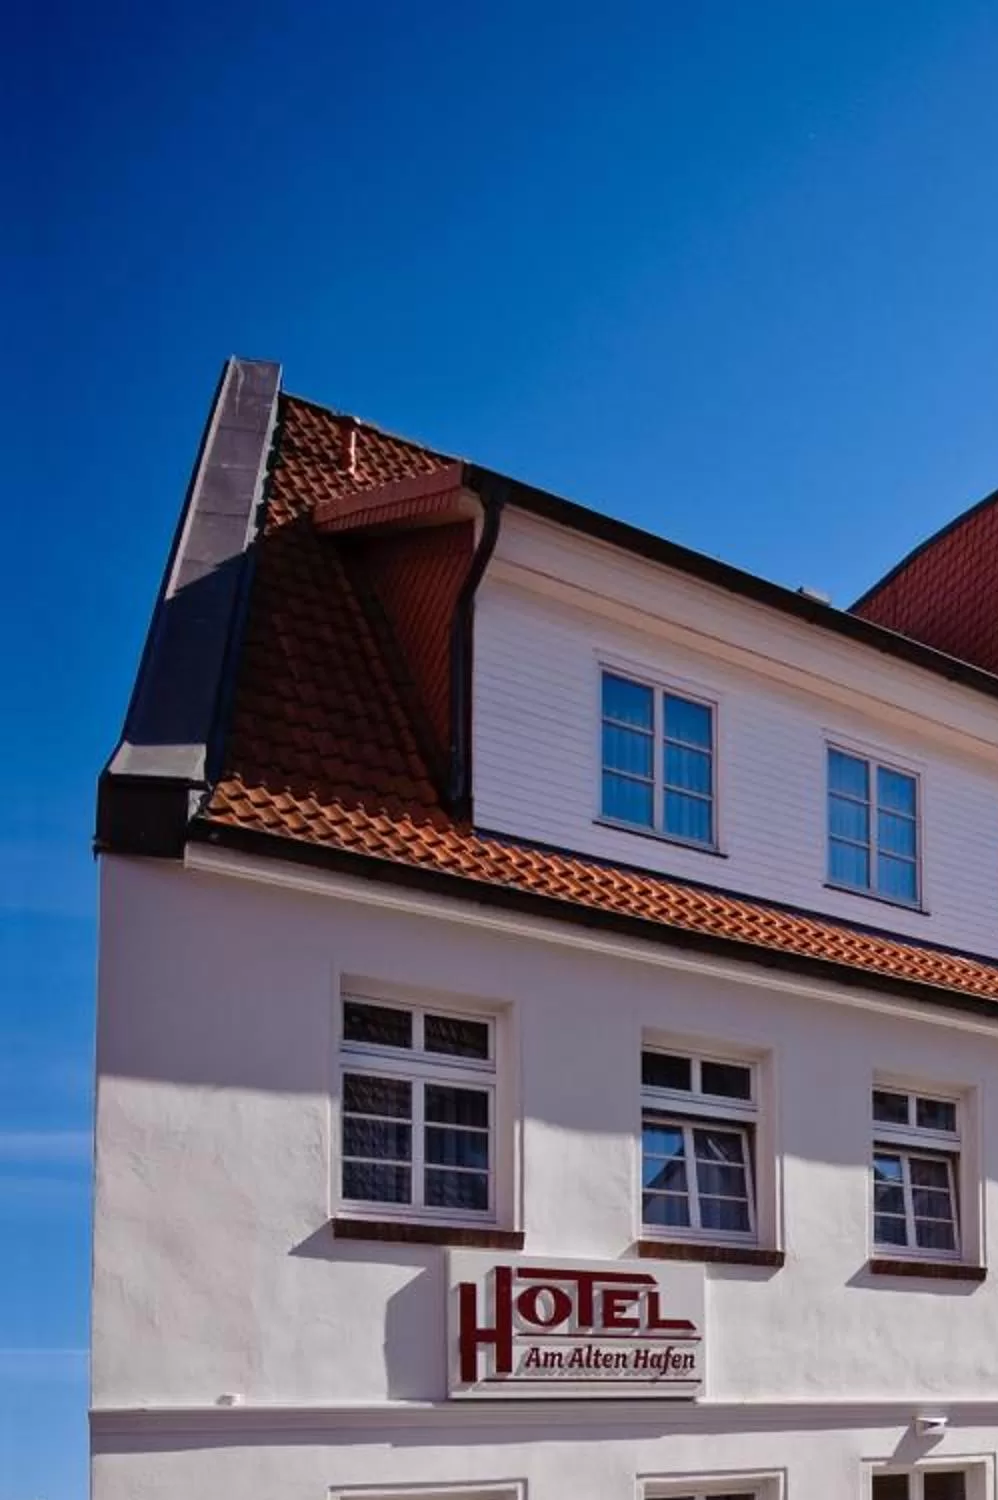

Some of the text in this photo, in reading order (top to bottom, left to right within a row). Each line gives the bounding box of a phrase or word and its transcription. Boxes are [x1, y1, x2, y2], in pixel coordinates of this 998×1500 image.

[459, 1266, 696, 1382] HOTEL
[525, 1344, 695, 1375] Am Alten Hafen
